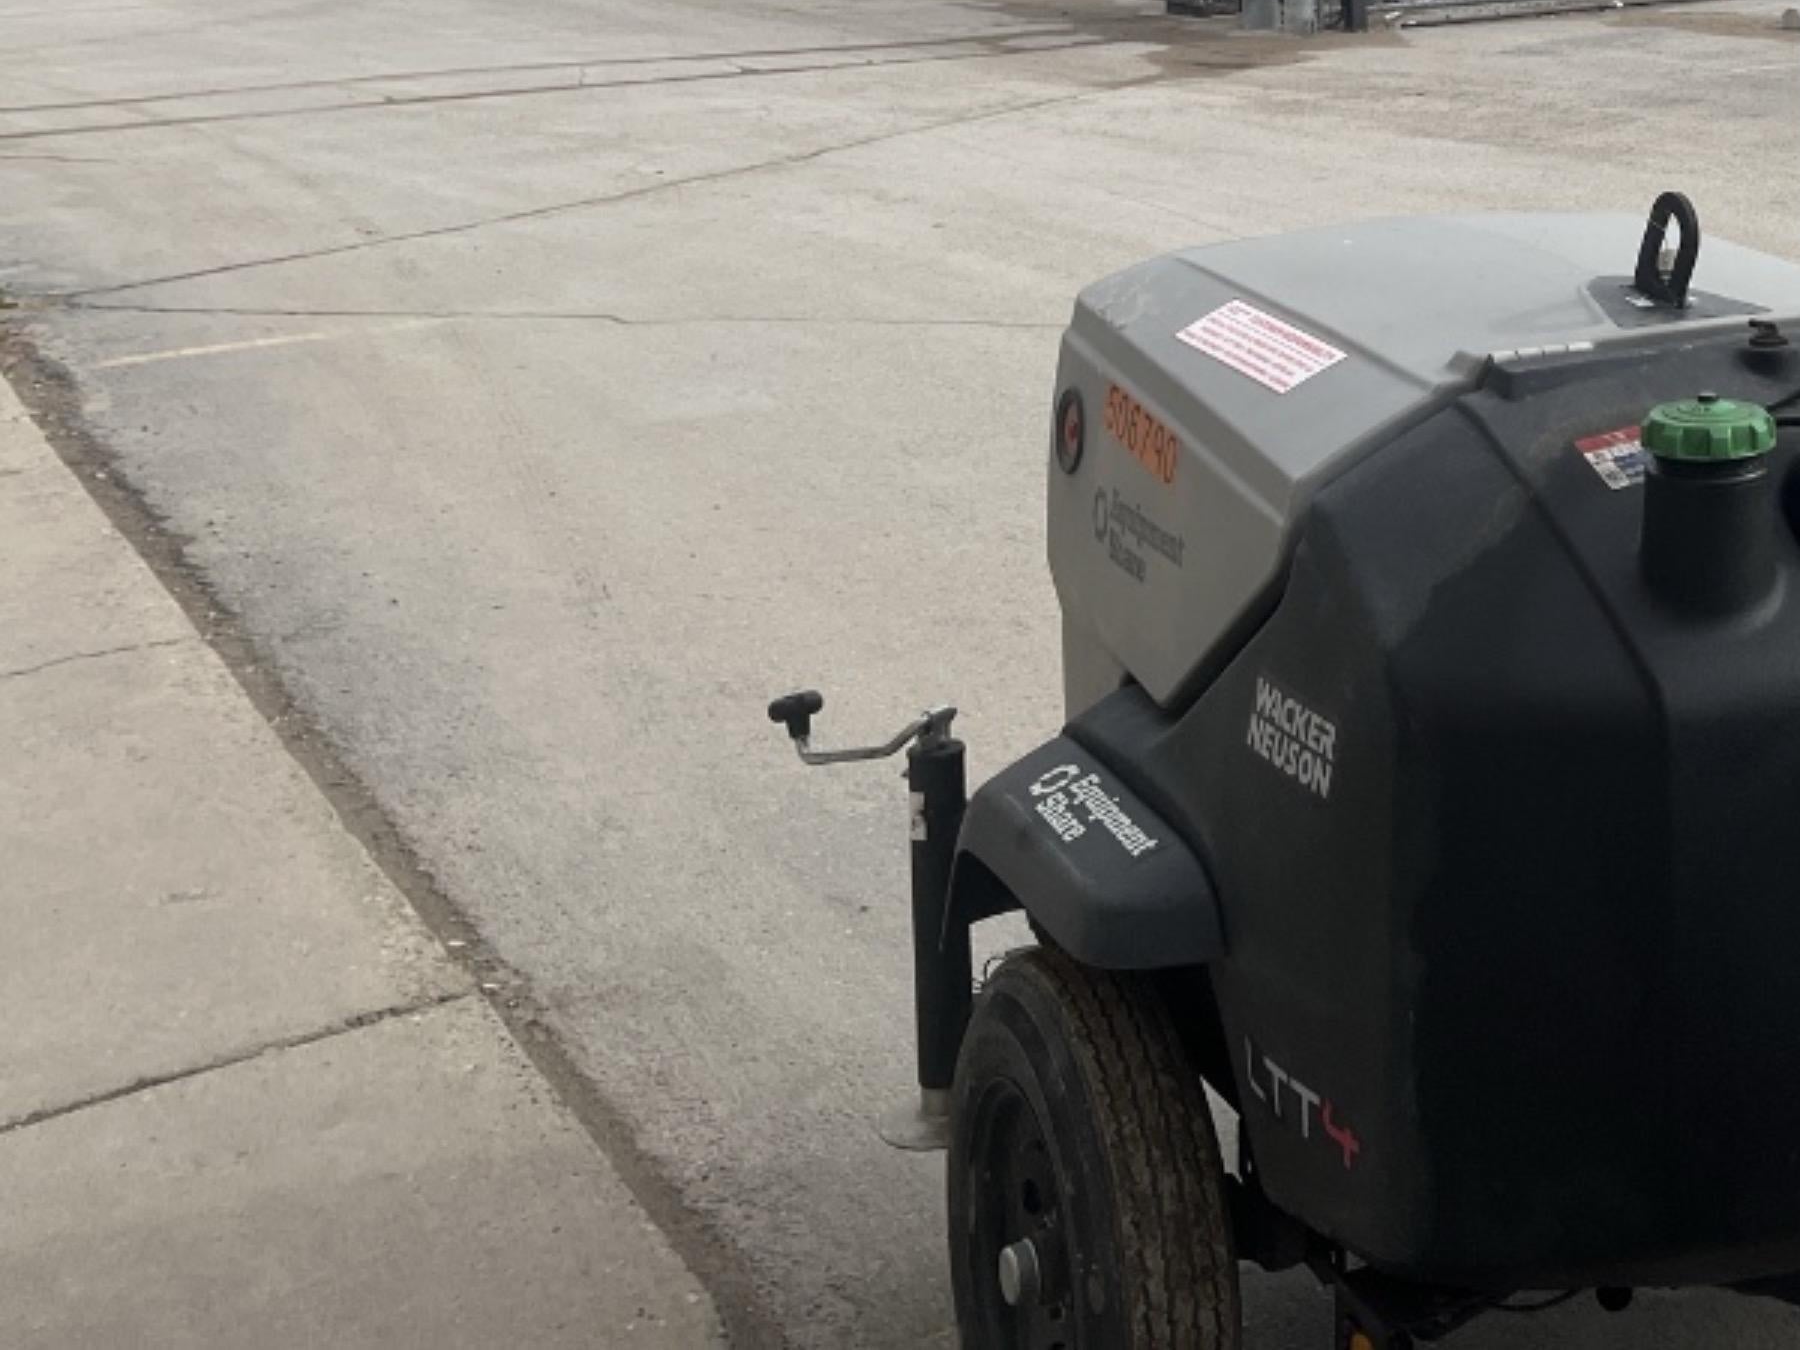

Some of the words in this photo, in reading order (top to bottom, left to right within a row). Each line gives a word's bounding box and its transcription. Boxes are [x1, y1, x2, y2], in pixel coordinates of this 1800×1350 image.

[1106, 383, 1178, 484] 506790
[1247, 713, 1332, 799] NEUSON
[1256, 677, 1336, 761] WACKER
[1035, 792, 1087, 842] Share
[1069, 773, 1159, 857] Equipment
[1244, 1034, 1360, 1170] LTT4
